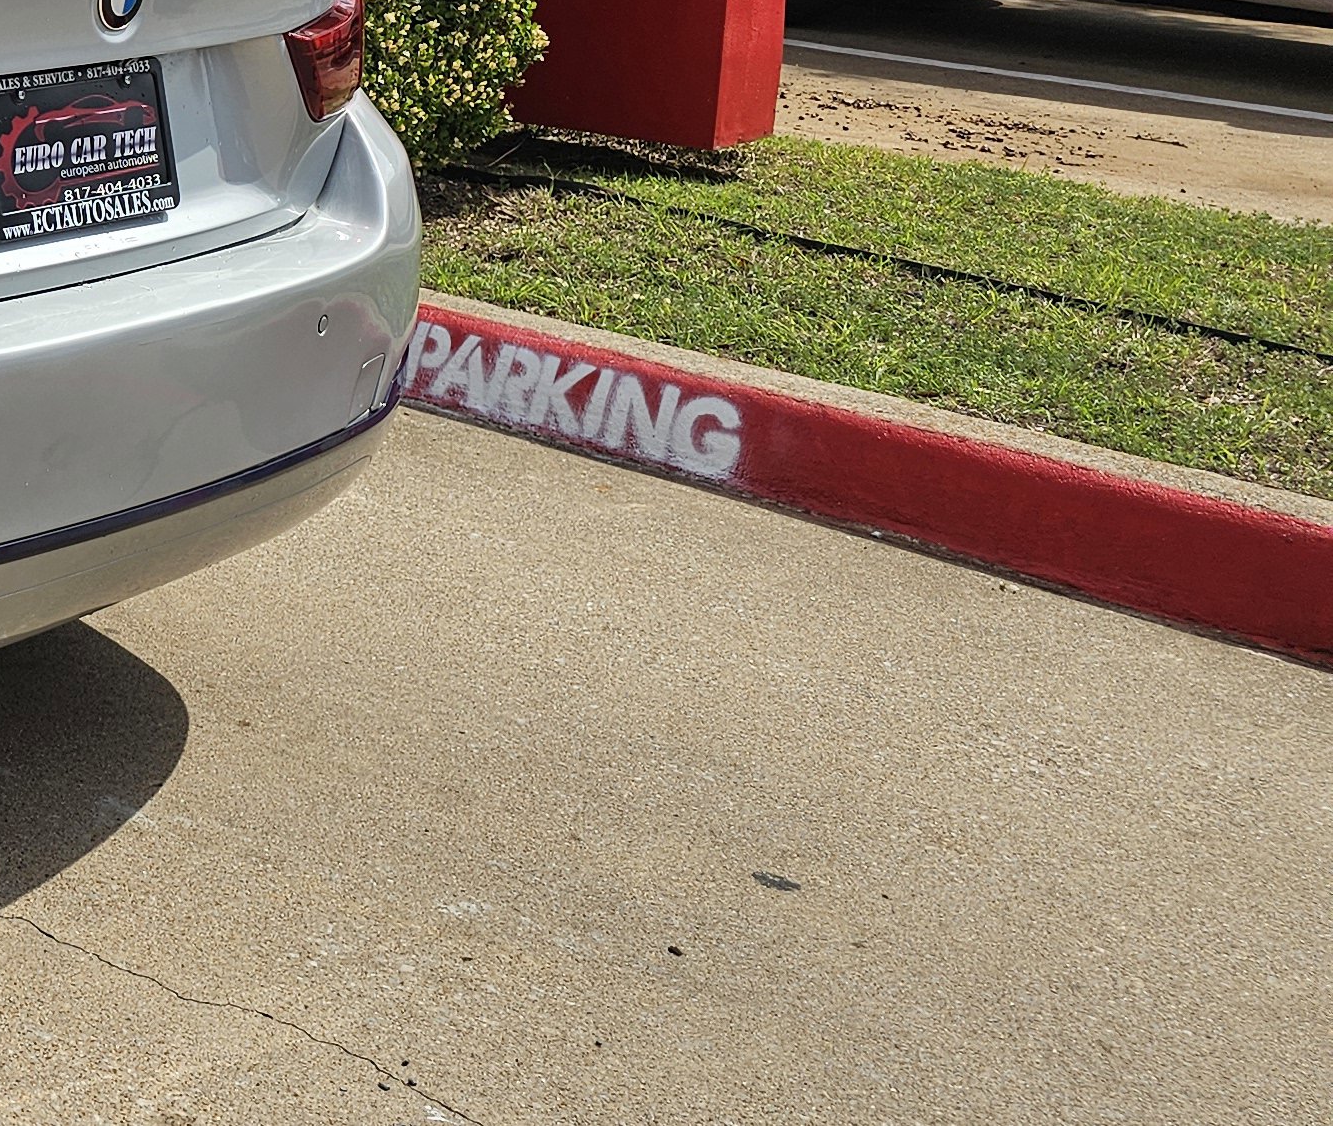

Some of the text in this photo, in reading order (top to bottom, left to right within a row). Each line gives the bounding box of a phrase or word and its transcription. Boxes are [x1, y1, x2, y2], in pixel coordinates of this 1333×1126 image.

[23, 76, 31, 88] &
[33, 70, 75, 87] SERVICE
[14, 126, 157, 175] EURO CAR TECH
[60, 153, 159, 178] european automotive
[64, 174, 161, 202] 817-404-4033
[2, 191, 175, 240] www.ECTAUTOSALES.com
[404, 321, 742, 480] PARKING
